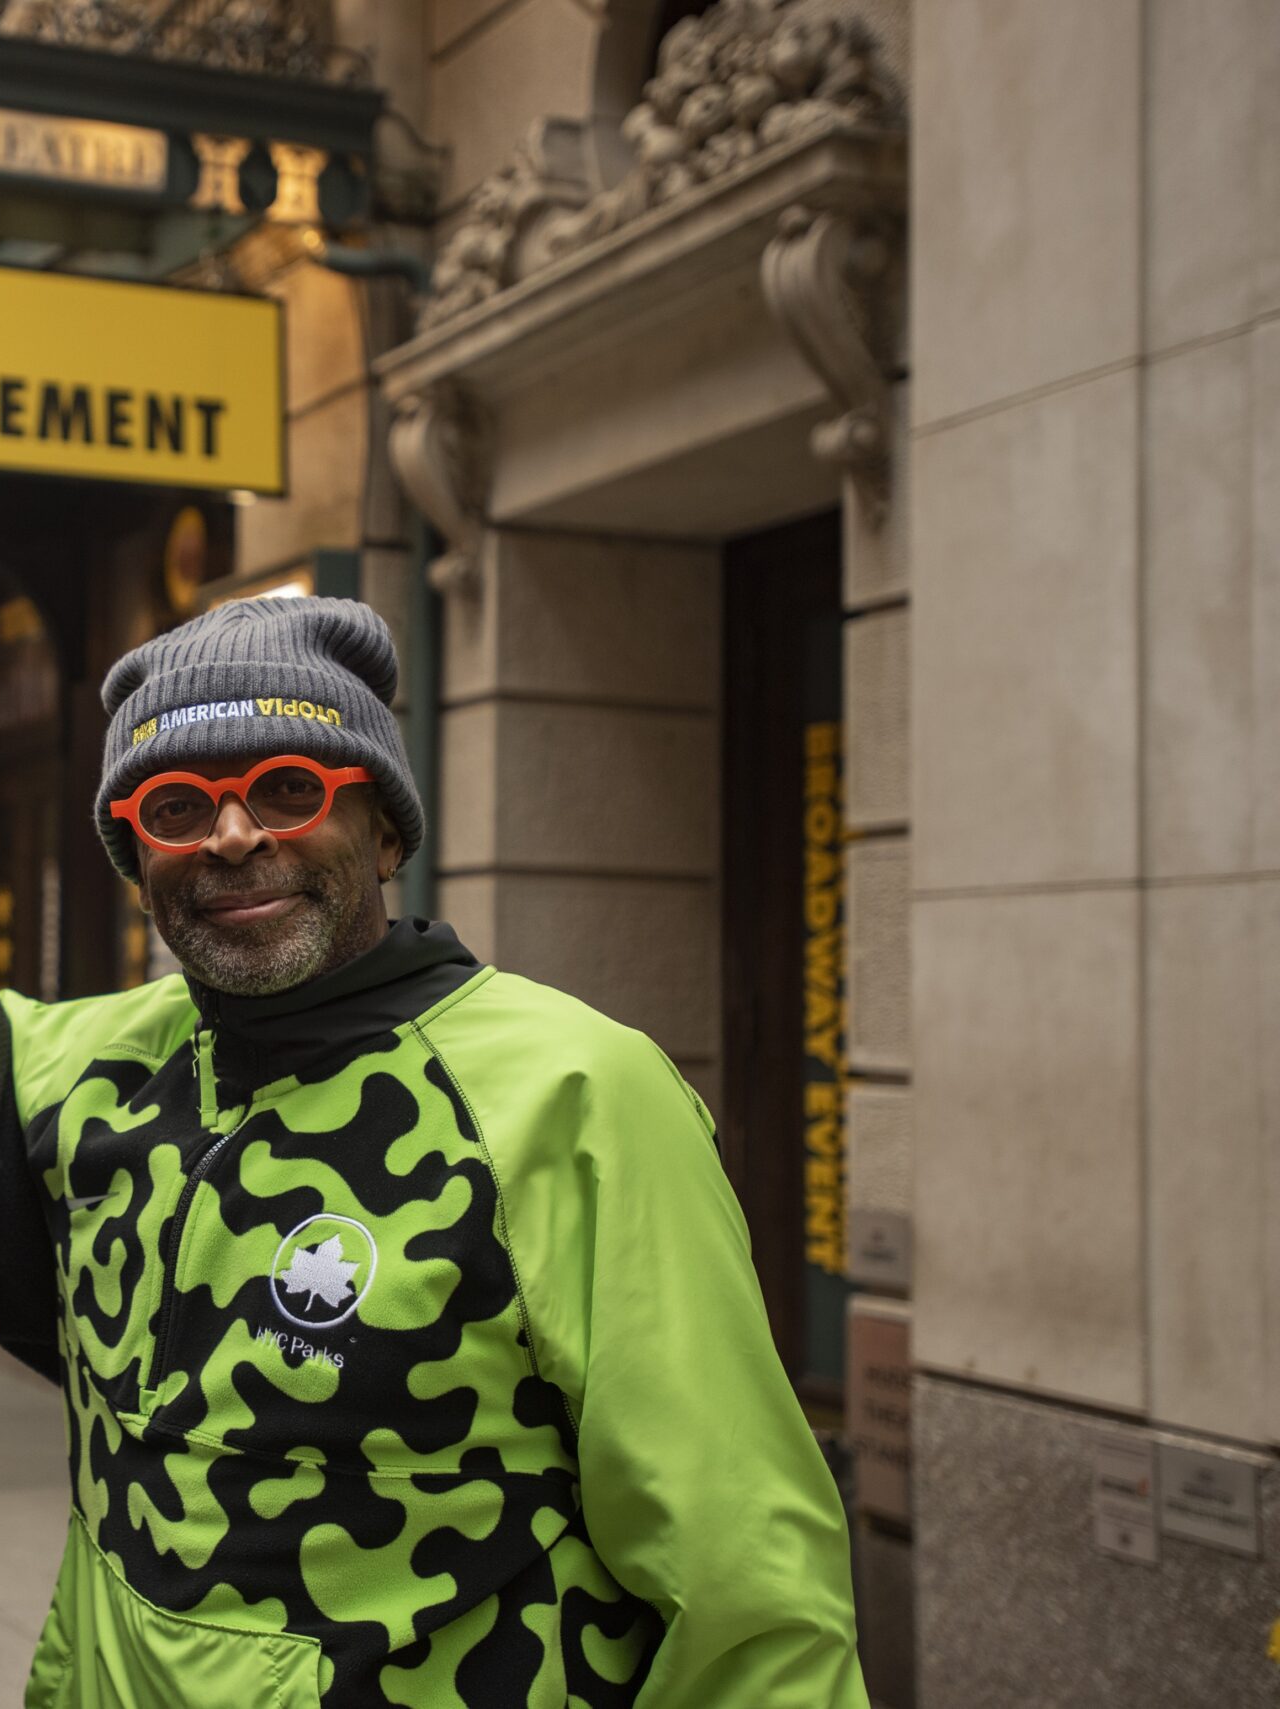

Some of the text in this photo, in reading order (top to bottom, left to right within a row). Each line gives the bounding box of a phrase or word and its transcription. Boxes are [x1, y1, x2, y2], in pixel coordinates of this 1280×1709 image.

[159, 697, 343, 731] AMERICAN UTOPIA
[256, 1325, 345, 1369] NYC Parks
